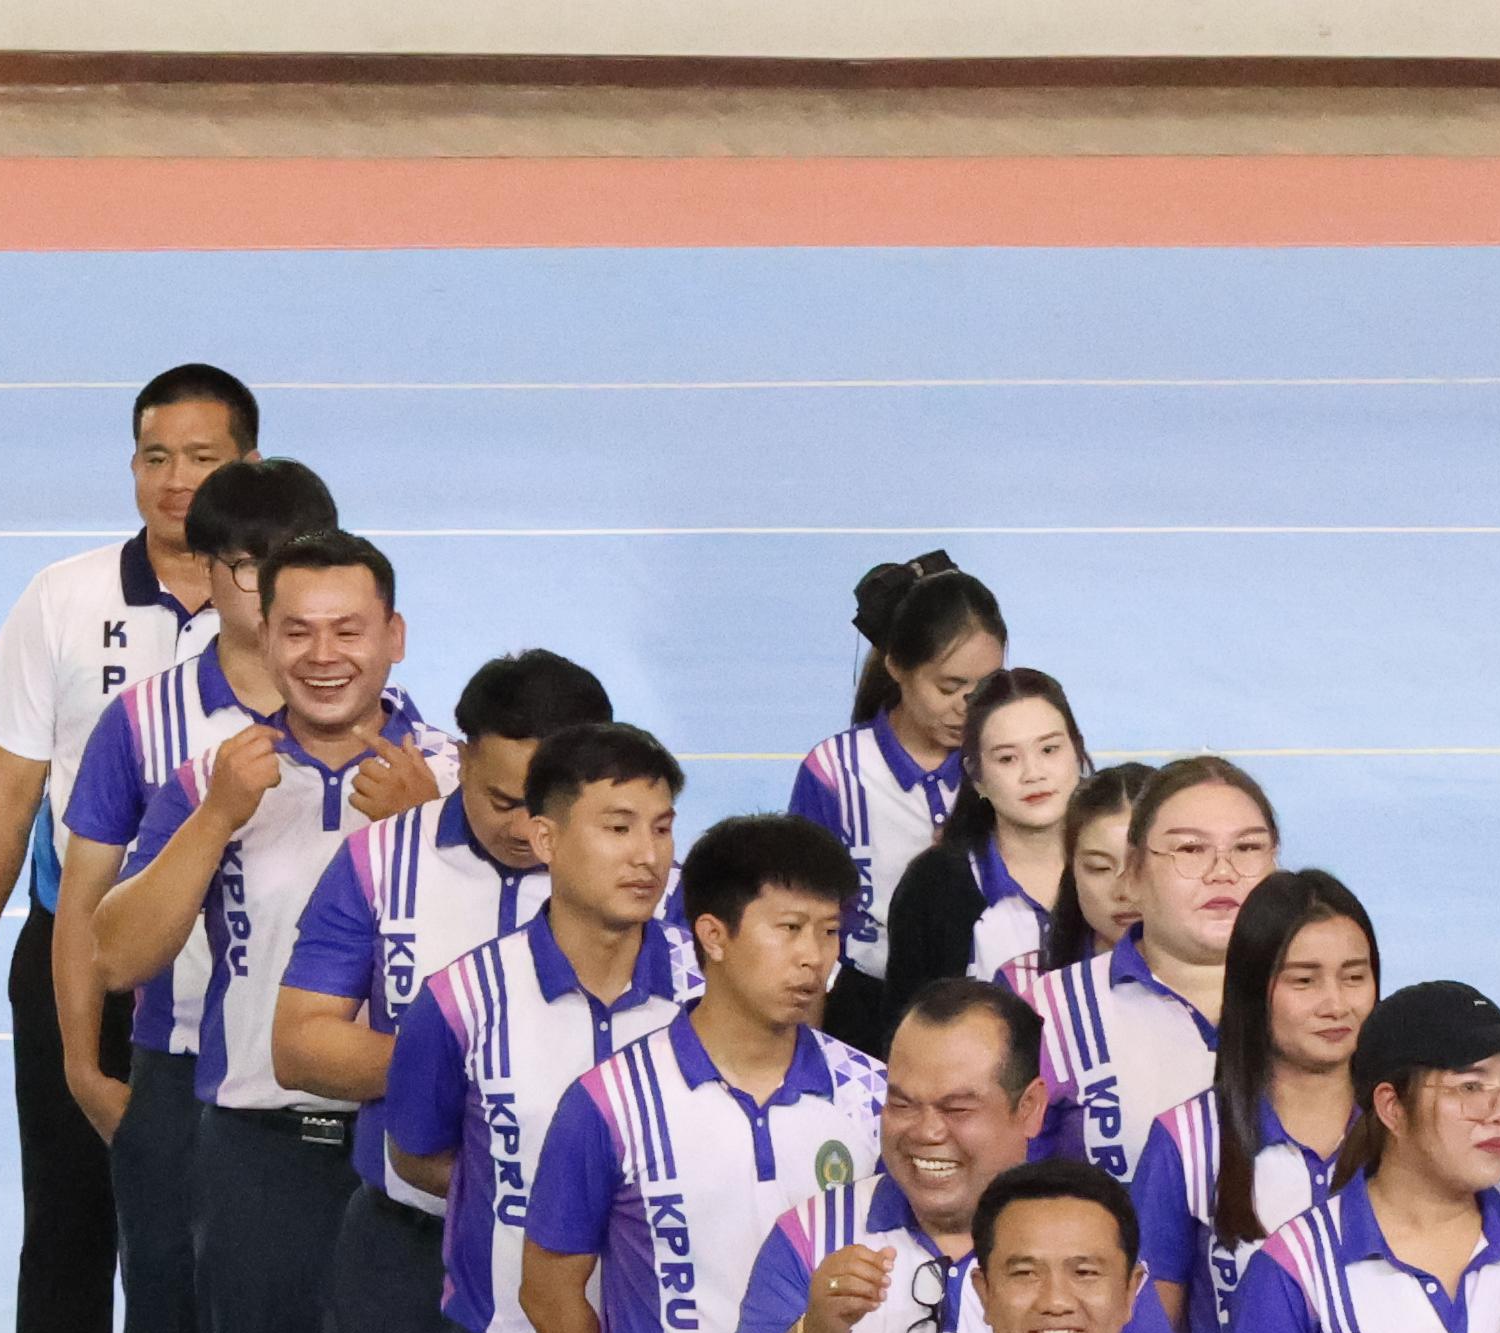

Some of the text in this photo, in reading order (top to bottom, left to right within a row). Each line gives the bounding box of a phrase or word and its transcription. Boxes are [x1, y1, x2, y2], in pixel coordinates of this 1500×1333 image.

[102, 620, 127, 694] KP
[482, 1093, 527, 1227] KPRU
[1083, 1075, 1128, 1176] KPR
[648, 1193, 699, 1330] KPRU
